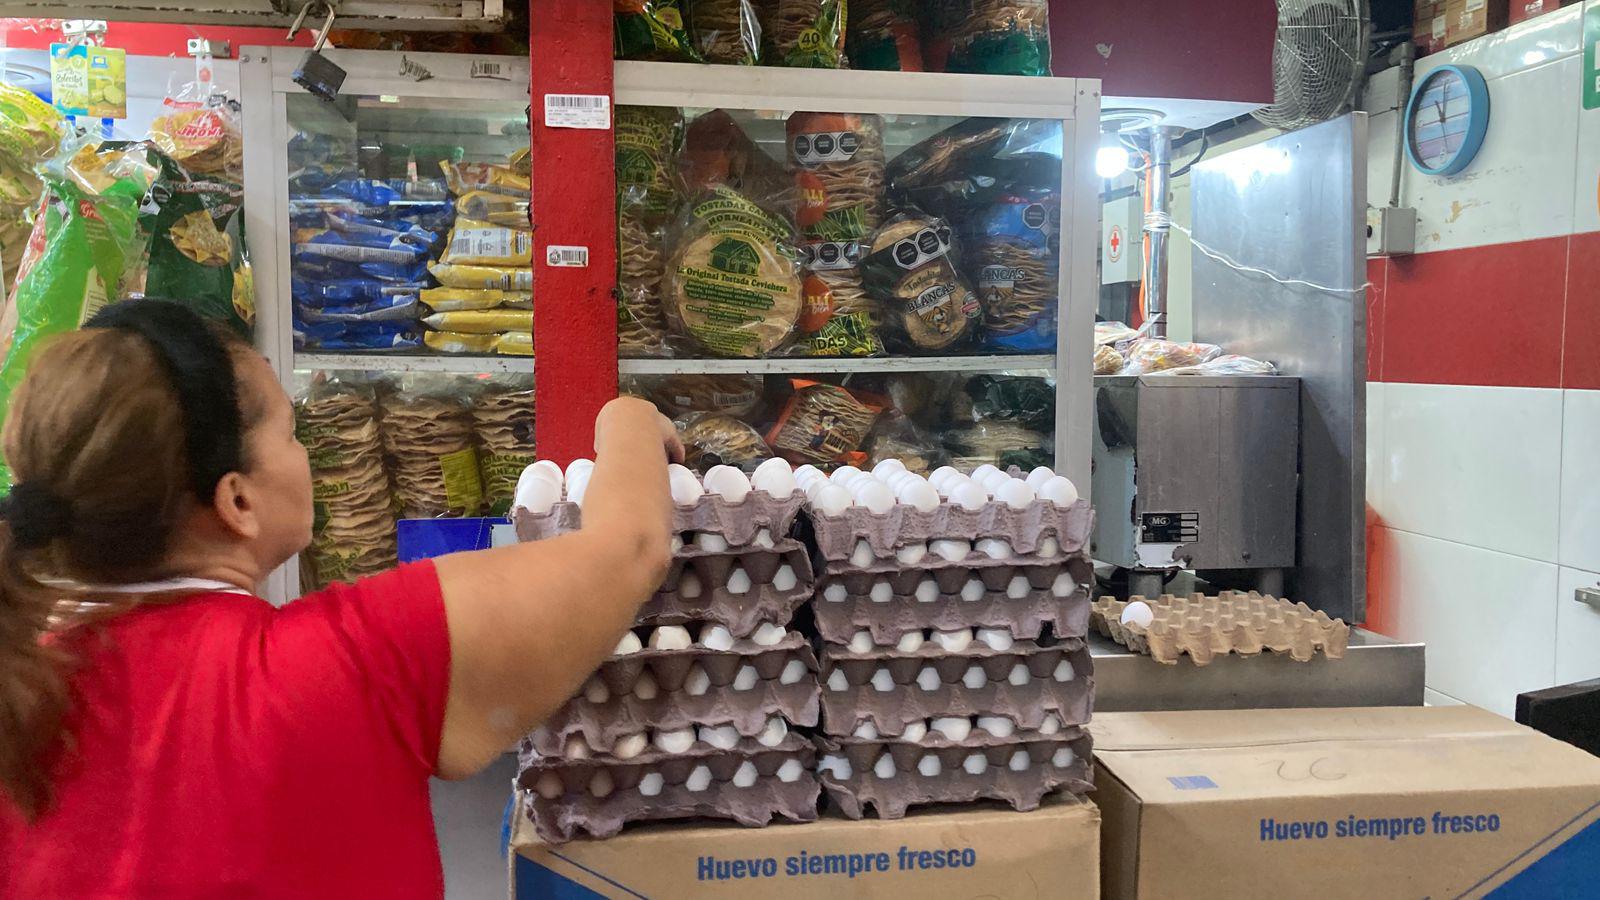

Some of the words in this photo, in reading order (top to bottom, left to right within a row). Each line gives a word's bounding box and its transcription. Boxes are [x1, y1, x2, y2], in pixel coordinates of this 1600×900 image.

[801, 32, 820, 45] 40
[693, 201, 746, 217] TOSTADAS
[686, 268, 719, 280] Original
[721, 273, 749, 285] Tostada
[751, 279, 788, 293] Cevichera
[907, 281, 957, 312] BLANCAS
[1152, 517, 1167, 525] MG
[1260, 818, 1329, 841] Huevo
[1335, 815, 1426, 840] siempre
[1431, 811, 1501, 833] fresco
[697, 856, 777, 881] Huevo
[785, 851, 891, 878] siempre
[897, 846, 976, 871] fresco
